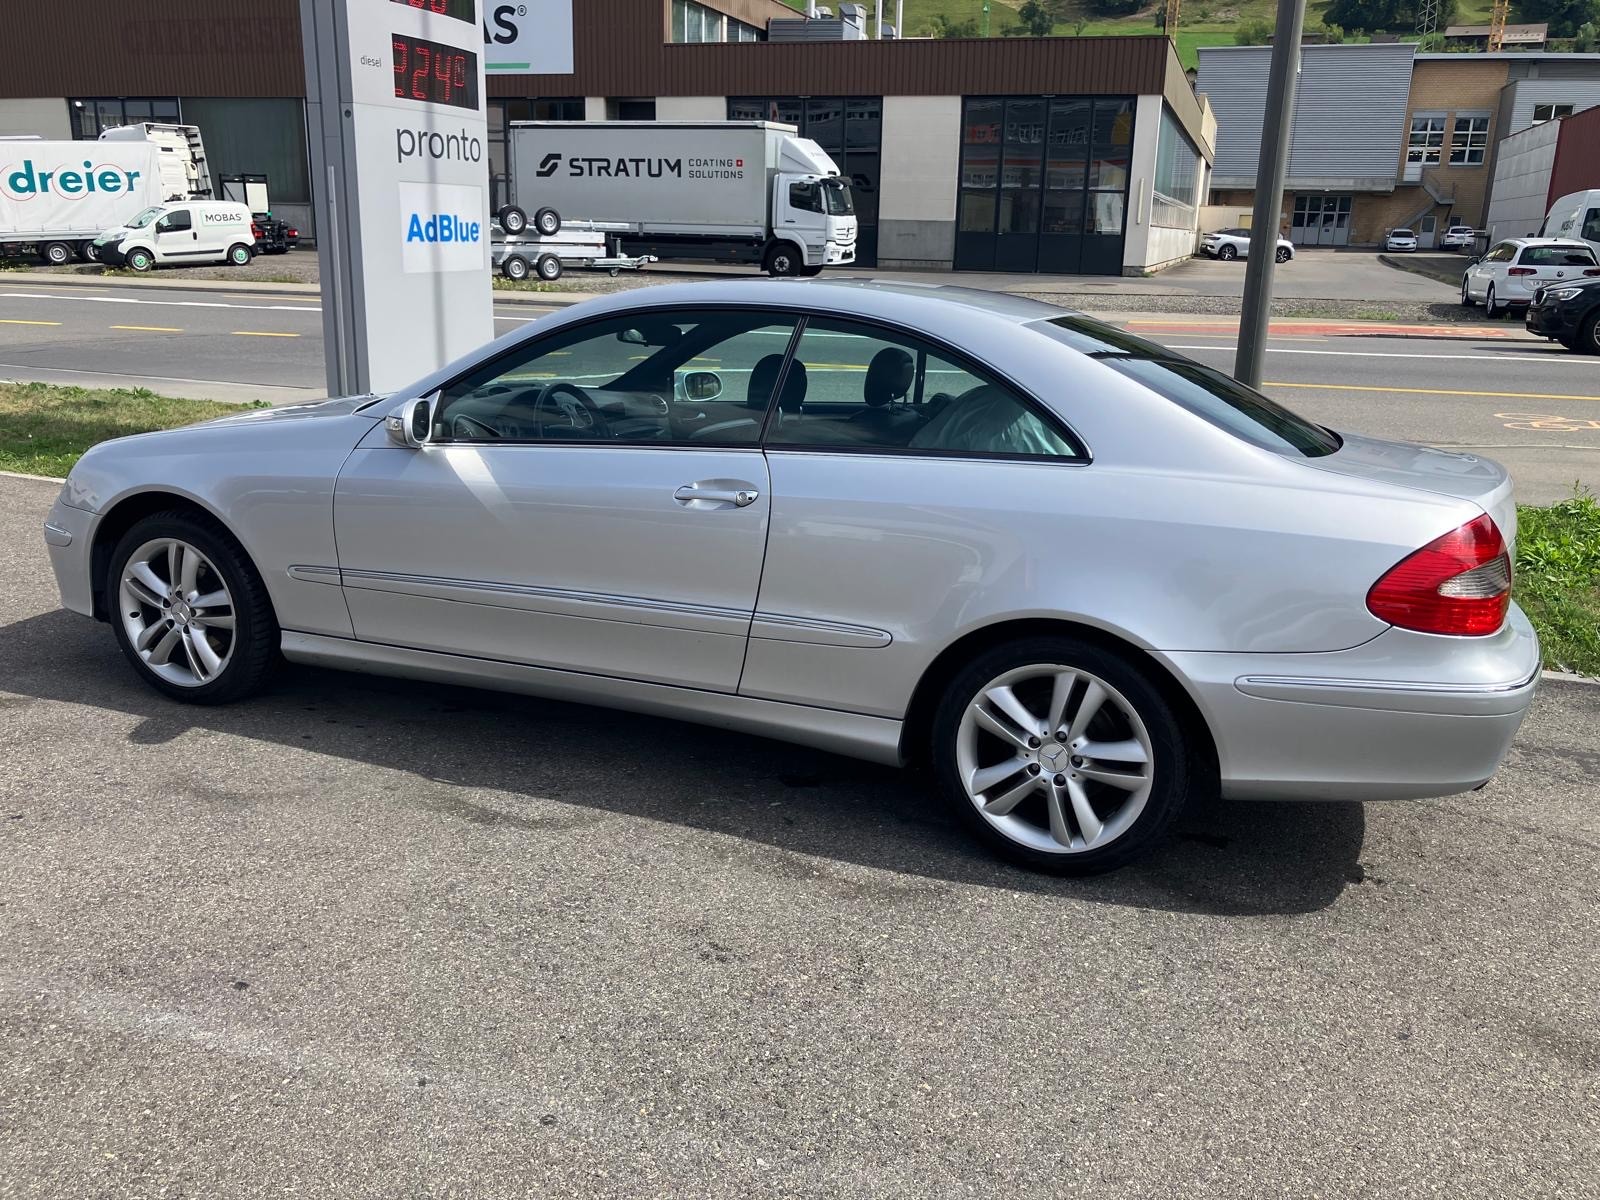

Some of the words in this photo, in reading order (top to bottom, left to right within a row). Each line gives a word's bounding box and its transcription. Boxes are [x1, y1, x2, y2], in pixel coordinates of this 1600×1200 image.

[360, 55, 383, 69] diesel
[396, 128, 481, 163] pronto
[569, 157, 682, 178] STRATUM
[688, 158, 733, 168] COATING
[688, 170, 744, 180] SOLUTIONS
[9, 160, 140, 193] dreier
[204, 213, 242, 222] MOBAS
